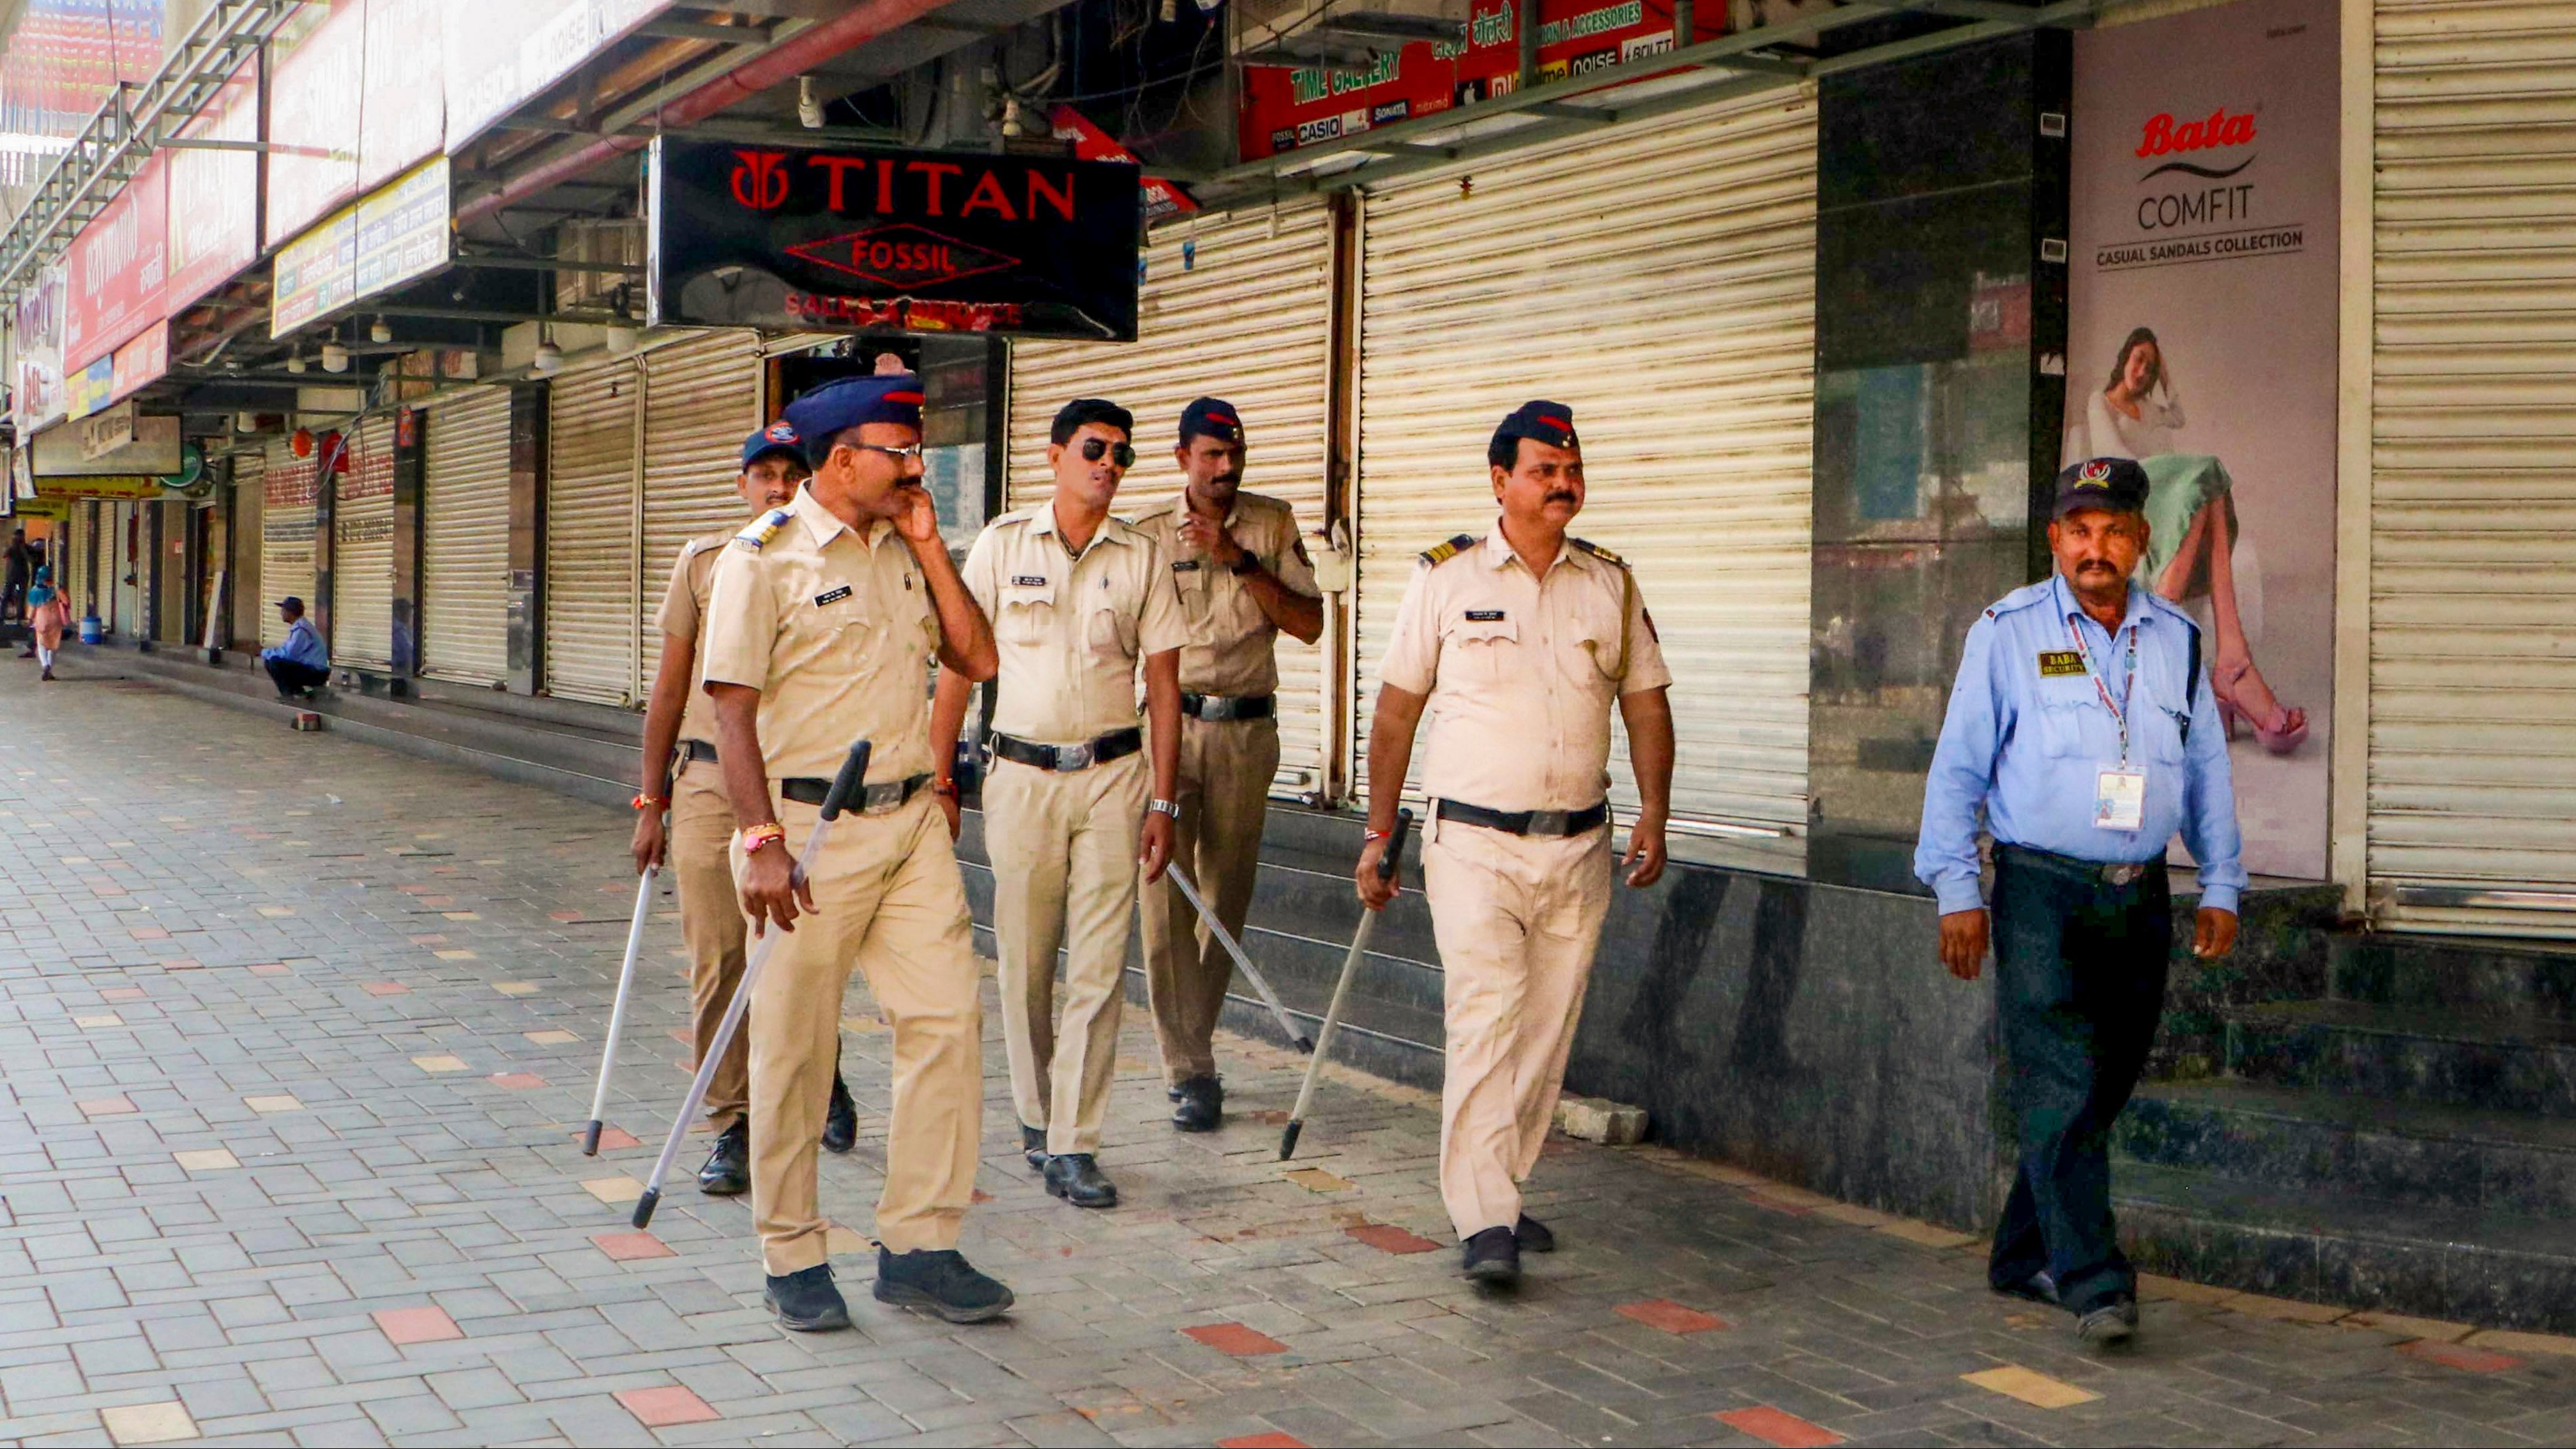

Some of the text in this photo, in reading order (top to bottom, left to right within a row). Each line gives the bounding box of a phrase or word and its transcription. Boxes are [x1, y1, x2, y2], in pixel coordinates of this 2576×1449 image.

[1572, 1, 1642, 38] ACCESSORIES
[1290, 49, 1400, 107] TIME GALLERY
[1374, 100, 1407, 124] SONATA
[1298, 117, 1340, 144] CASIO
[2135, 107, 2256, 158] Bata
[807, 155, 1075, 221] TITAN
[2137, 185, 2254, 229] COMFIT
[851, 239, 957, 271] FOSSIL
[2097, 231, 2303, 266] CASUAL SANDALS COLLECTION
[784, 293, 874, 320] SALES
[909, 300, 1022, 325] SERVICE
[2050, 654, 2077, 664] BABA
